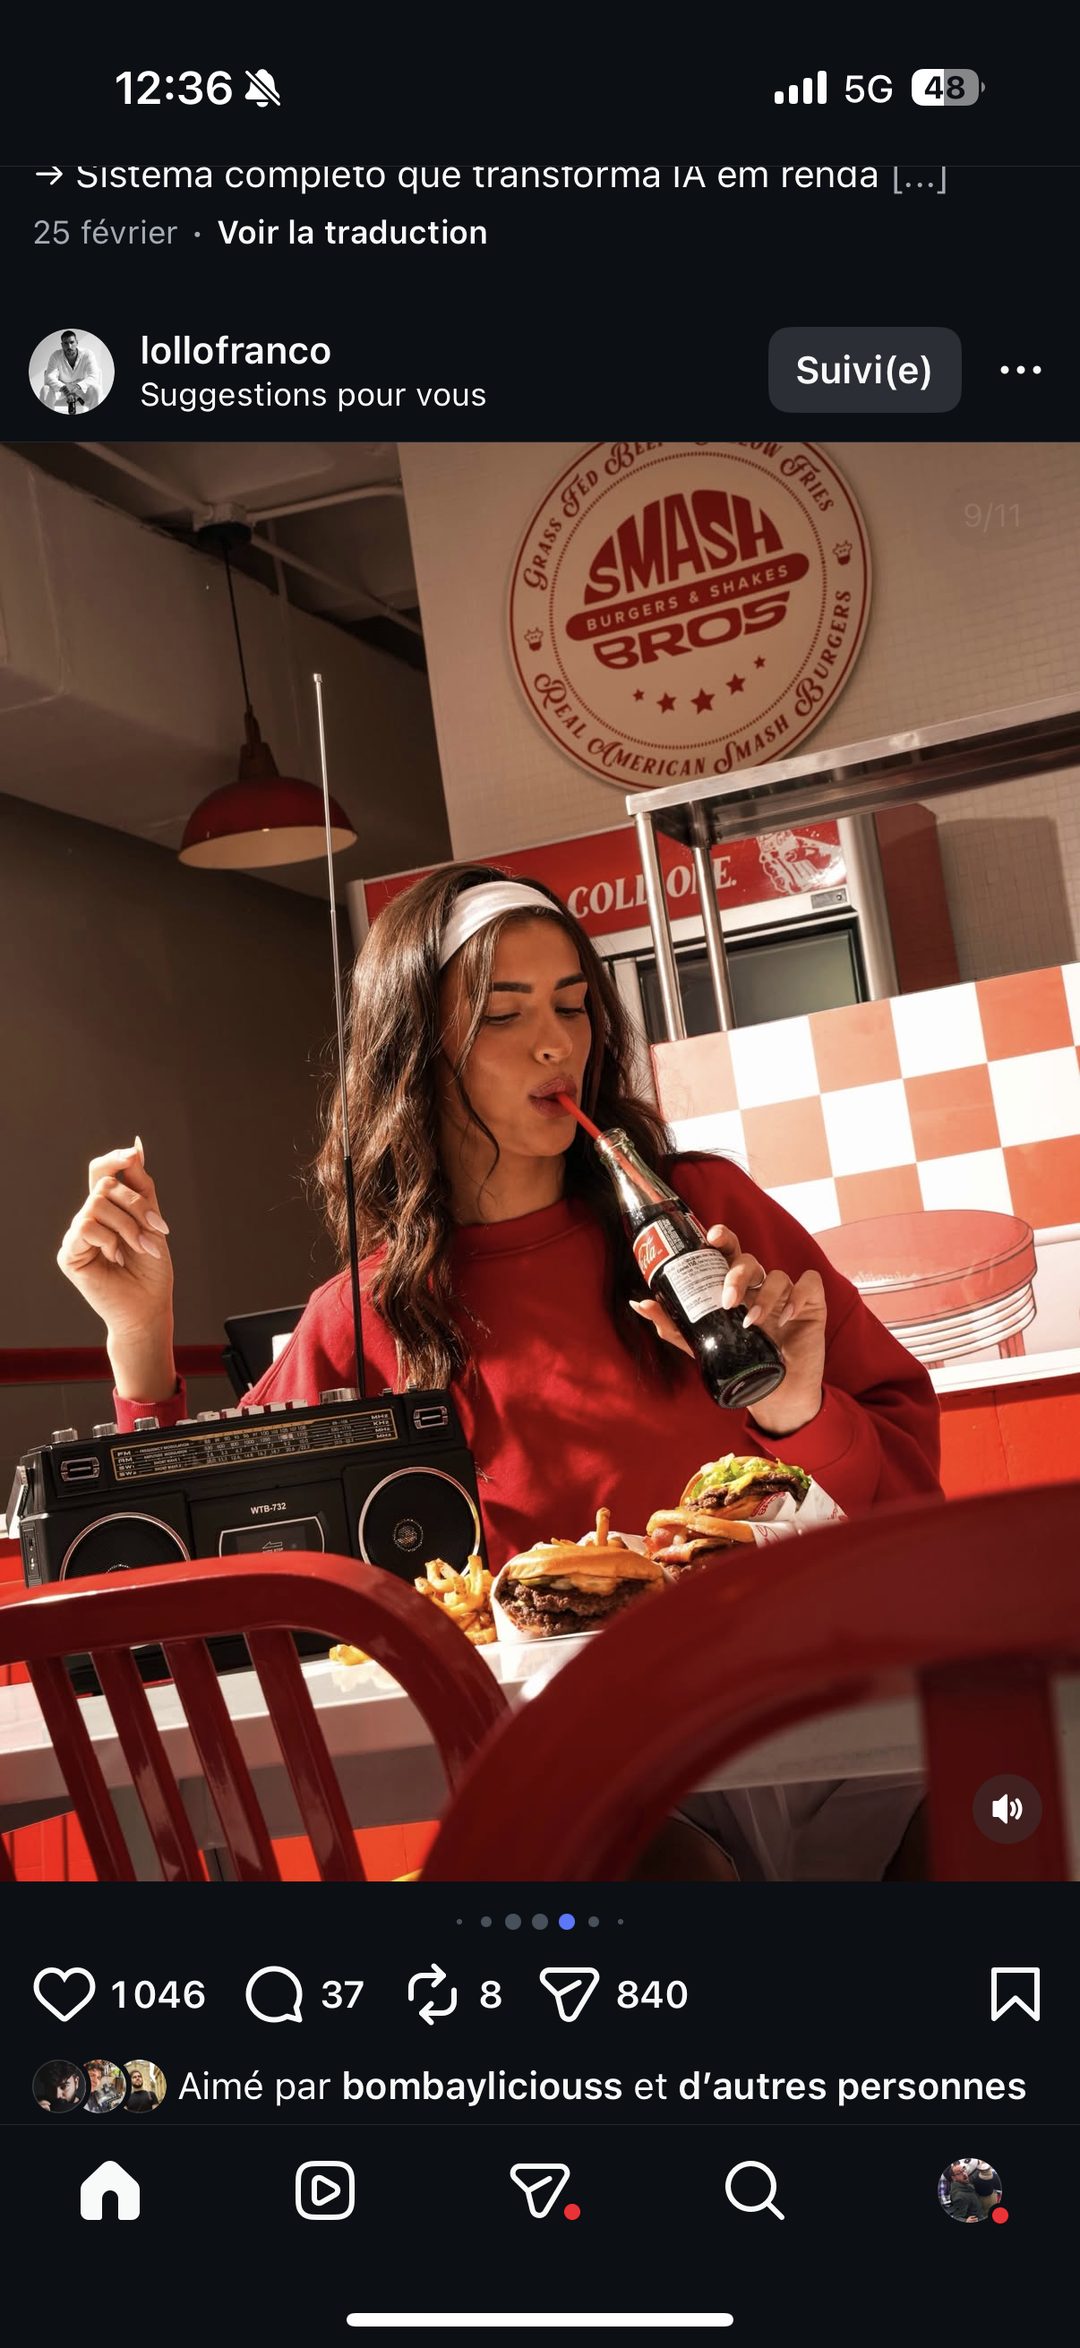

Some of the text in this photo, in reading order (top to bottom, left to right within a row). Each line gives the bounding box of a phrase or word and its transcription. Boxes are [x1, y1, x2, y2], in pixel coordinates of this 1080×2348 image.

[584, 489, 784, 606] SMASH
[586, 564, 790, 632] BURGERS & SHAKES
[593, 590, 791, 670] BROS
[587, 737, 706, 778] AMERICAN
[712, 713, 791, 775] SMASH
[793, 589, 852, 718] BURGERS
[666, 856, 738, 898] OE.
[250, 1502, 287, 1515] WTB-732
